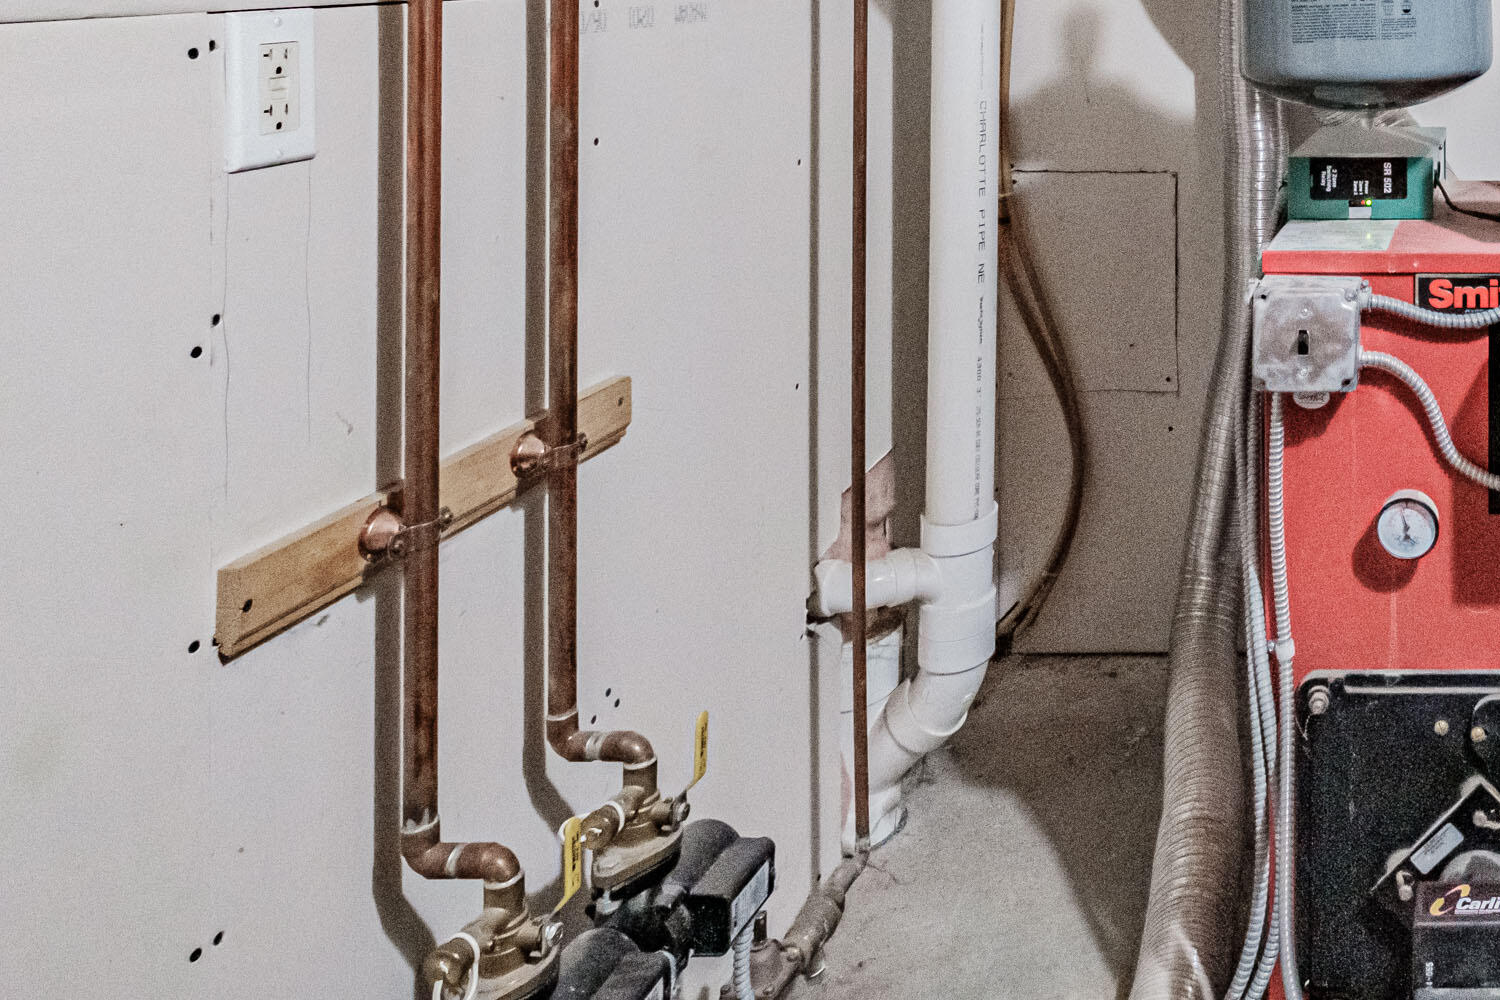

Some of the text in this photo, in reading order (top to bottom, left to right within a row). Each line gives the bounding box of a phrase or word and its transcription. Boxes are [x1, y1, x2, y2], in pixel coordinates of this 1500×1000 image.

[978, 99, 989, 198] CHARLOTTE
[1325, 165, 1333, 192] Switching
[1383, 162, 1392, 194] SR 502
[977, 209, 987, 253] PIPE
